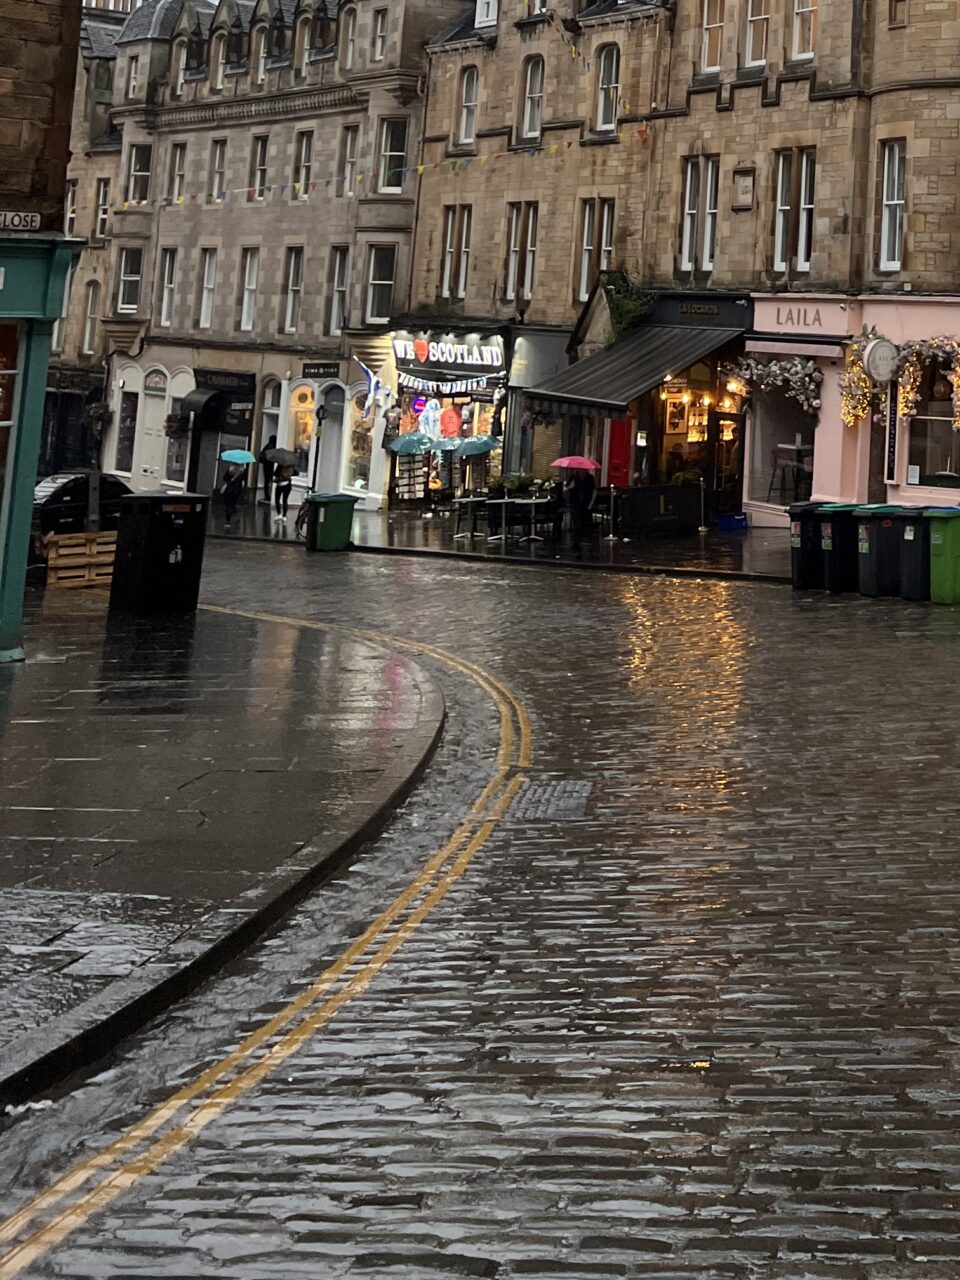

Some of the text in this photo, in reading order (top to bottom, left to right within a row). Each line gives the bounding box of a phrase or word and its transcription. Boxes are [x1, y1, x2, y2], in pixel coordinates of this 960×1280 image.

[0, 213, 38, 227] LOSE
[776, 307, 822, 328] LAILA
[393, 339, 502, 367] WE SCOTLAND
